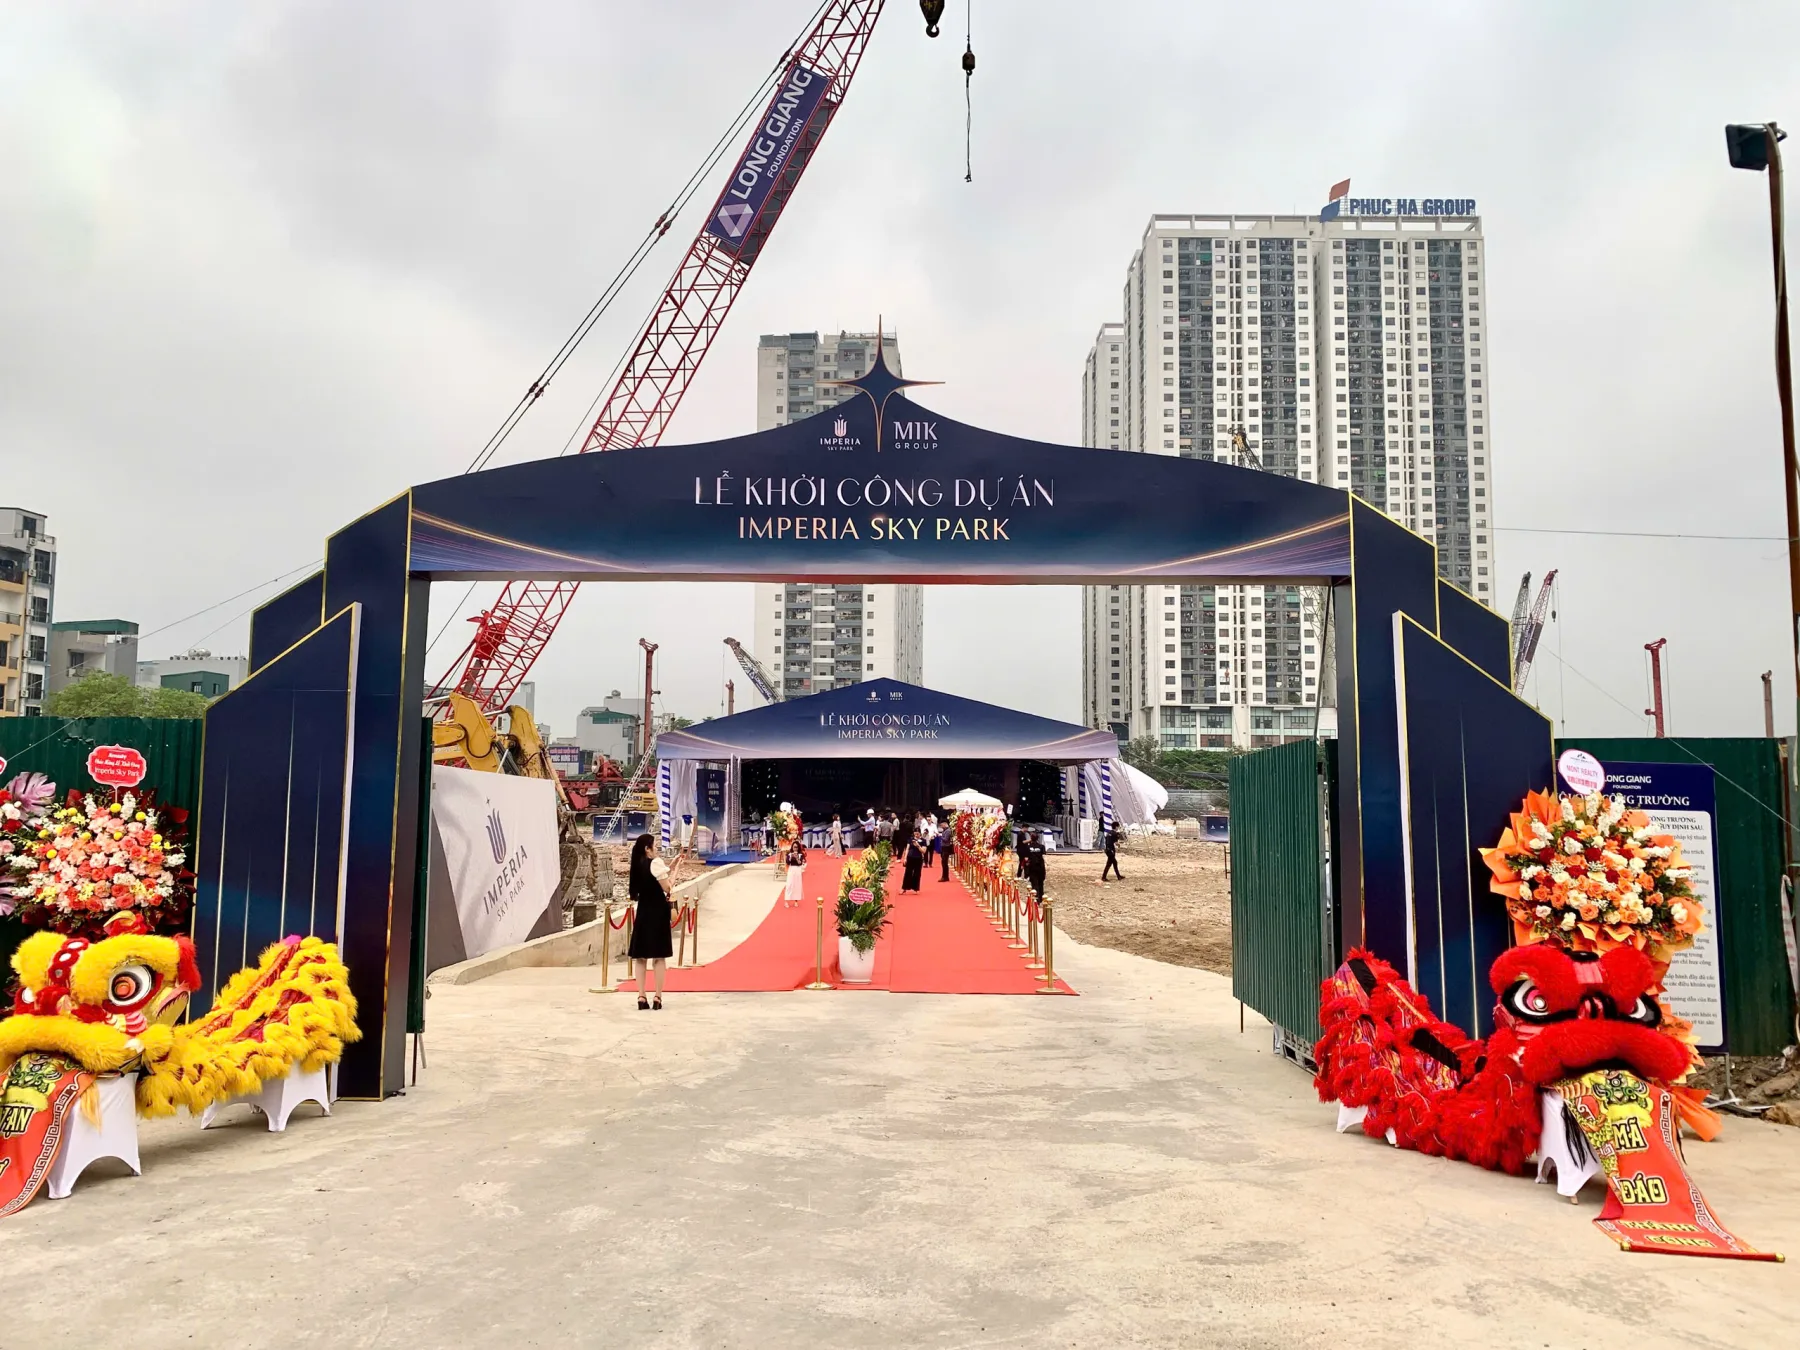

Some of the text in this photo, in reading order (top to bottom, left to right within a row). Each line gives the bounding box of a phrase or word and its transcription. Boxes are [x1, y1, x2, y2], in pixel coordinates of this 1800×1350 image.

[730, 69, 812, 200] LONG GIANG
[767, 118, 804, 178] FOUNDATION
[1350, 199, 1476, 215] PHUC HA GROUP
[893, 421, 937, 440] MIK
[695, 470, 1055, 511] LỄ KHỞI CÔNG DỰ ÁN
[738, 517, 1010, 541] IMPERIA SKY PARK
[821, 712, 950, 727] LỄ KHỞI CÔNG DỰ ÁN
[838, 729, 938, 739] IMPERIA SKY PARK
[1626, 776, 1652, 784] GIANG
[1637, 794, 1690, 806] TRƯỜNG
[483, 845, 528, 914] IMPERIA
[498, 876, 524, 922] SKY PARK
[1613, 1117, 1649, 1151] MÃ
[1619, 1171, 1670, 1205] ĐÁO
